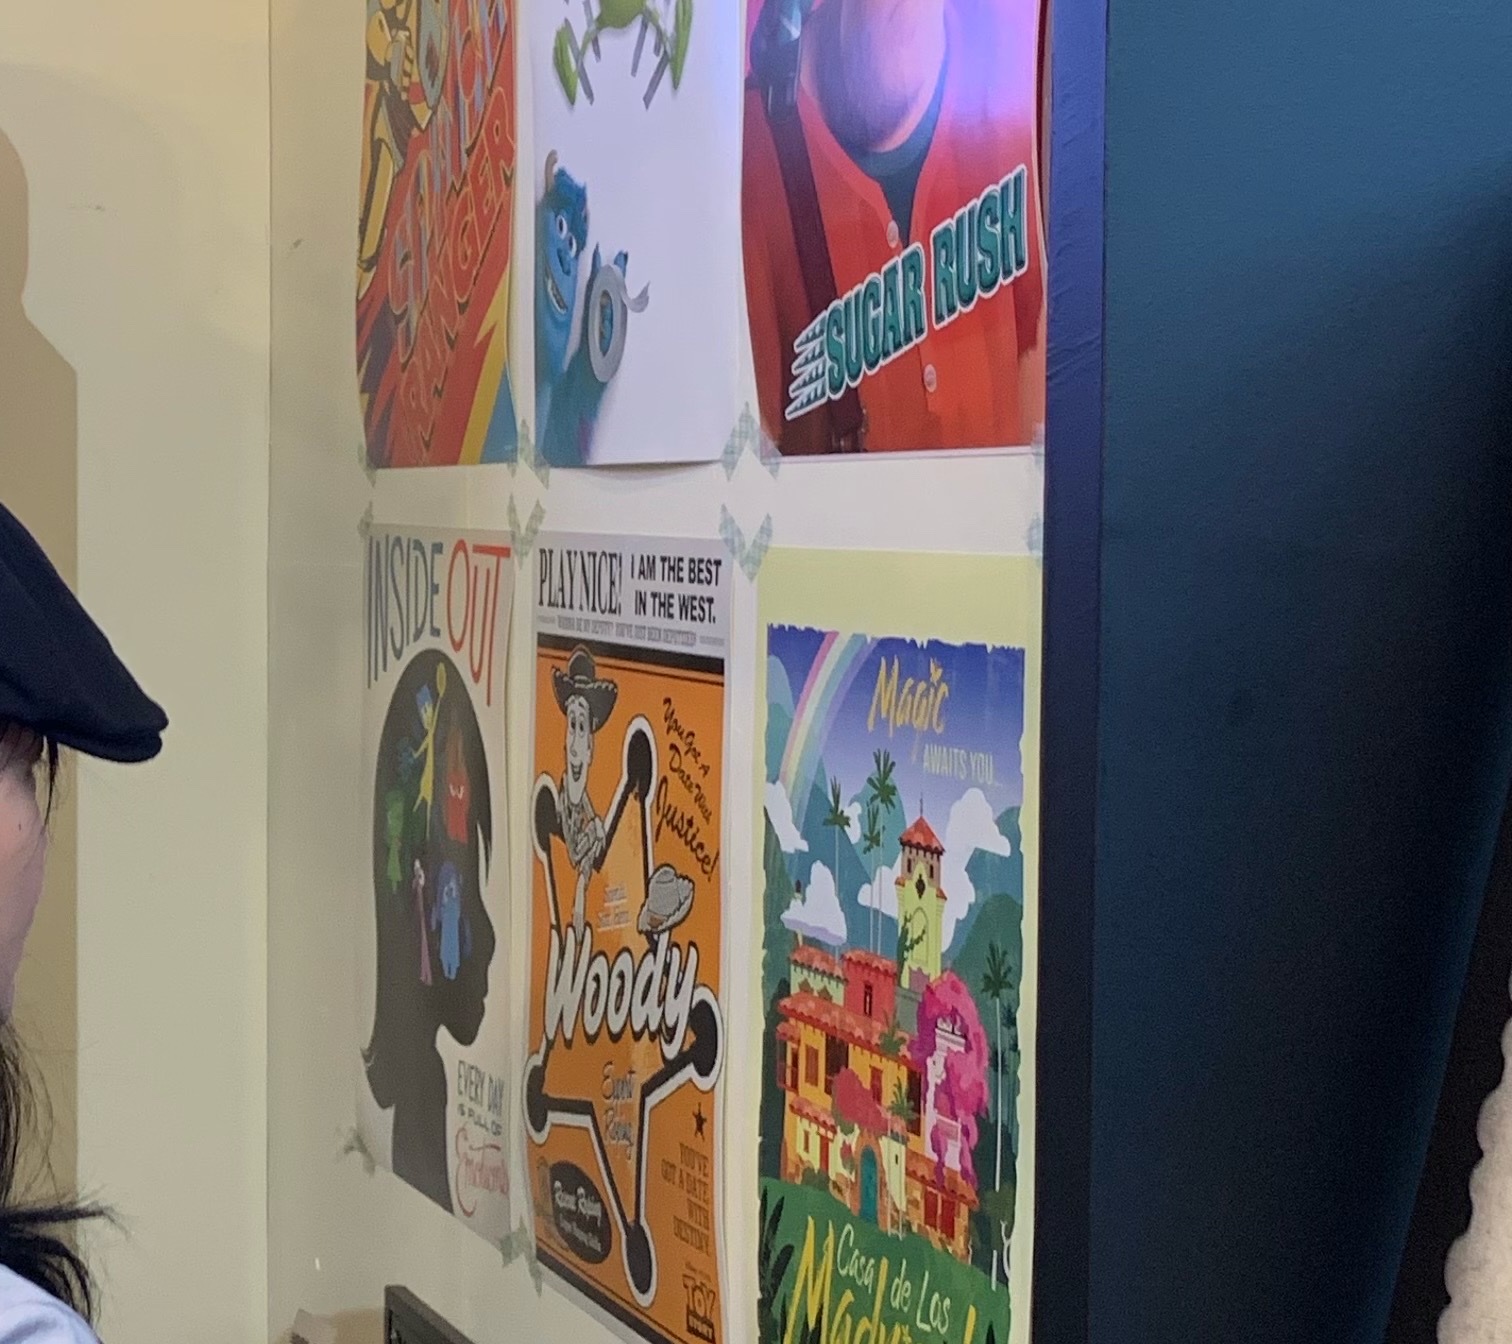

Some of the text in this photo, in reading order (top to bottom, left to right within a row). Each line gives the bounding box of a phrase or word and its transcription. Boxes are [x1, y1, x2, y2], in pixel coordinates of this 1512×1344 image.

[824, 164, 1028, 400] SUGAR RUSH
[538, 548, 623, 616] PLAY NICE!
[630, 553, 722, 586] I AM THE BEST
[367, 533, 511, 707] INSIDE OUT
[634, 590, 716, 623] IN THE WEST.
[924, 744, 967, 780] AWAITS
[544, 921, 698, 1059] Woody
[457, 1060, 485, 1107] EVERY
[682, 1274, 716, 1321] TOY
[837, 1223, 950, 1334] Casa de Los
